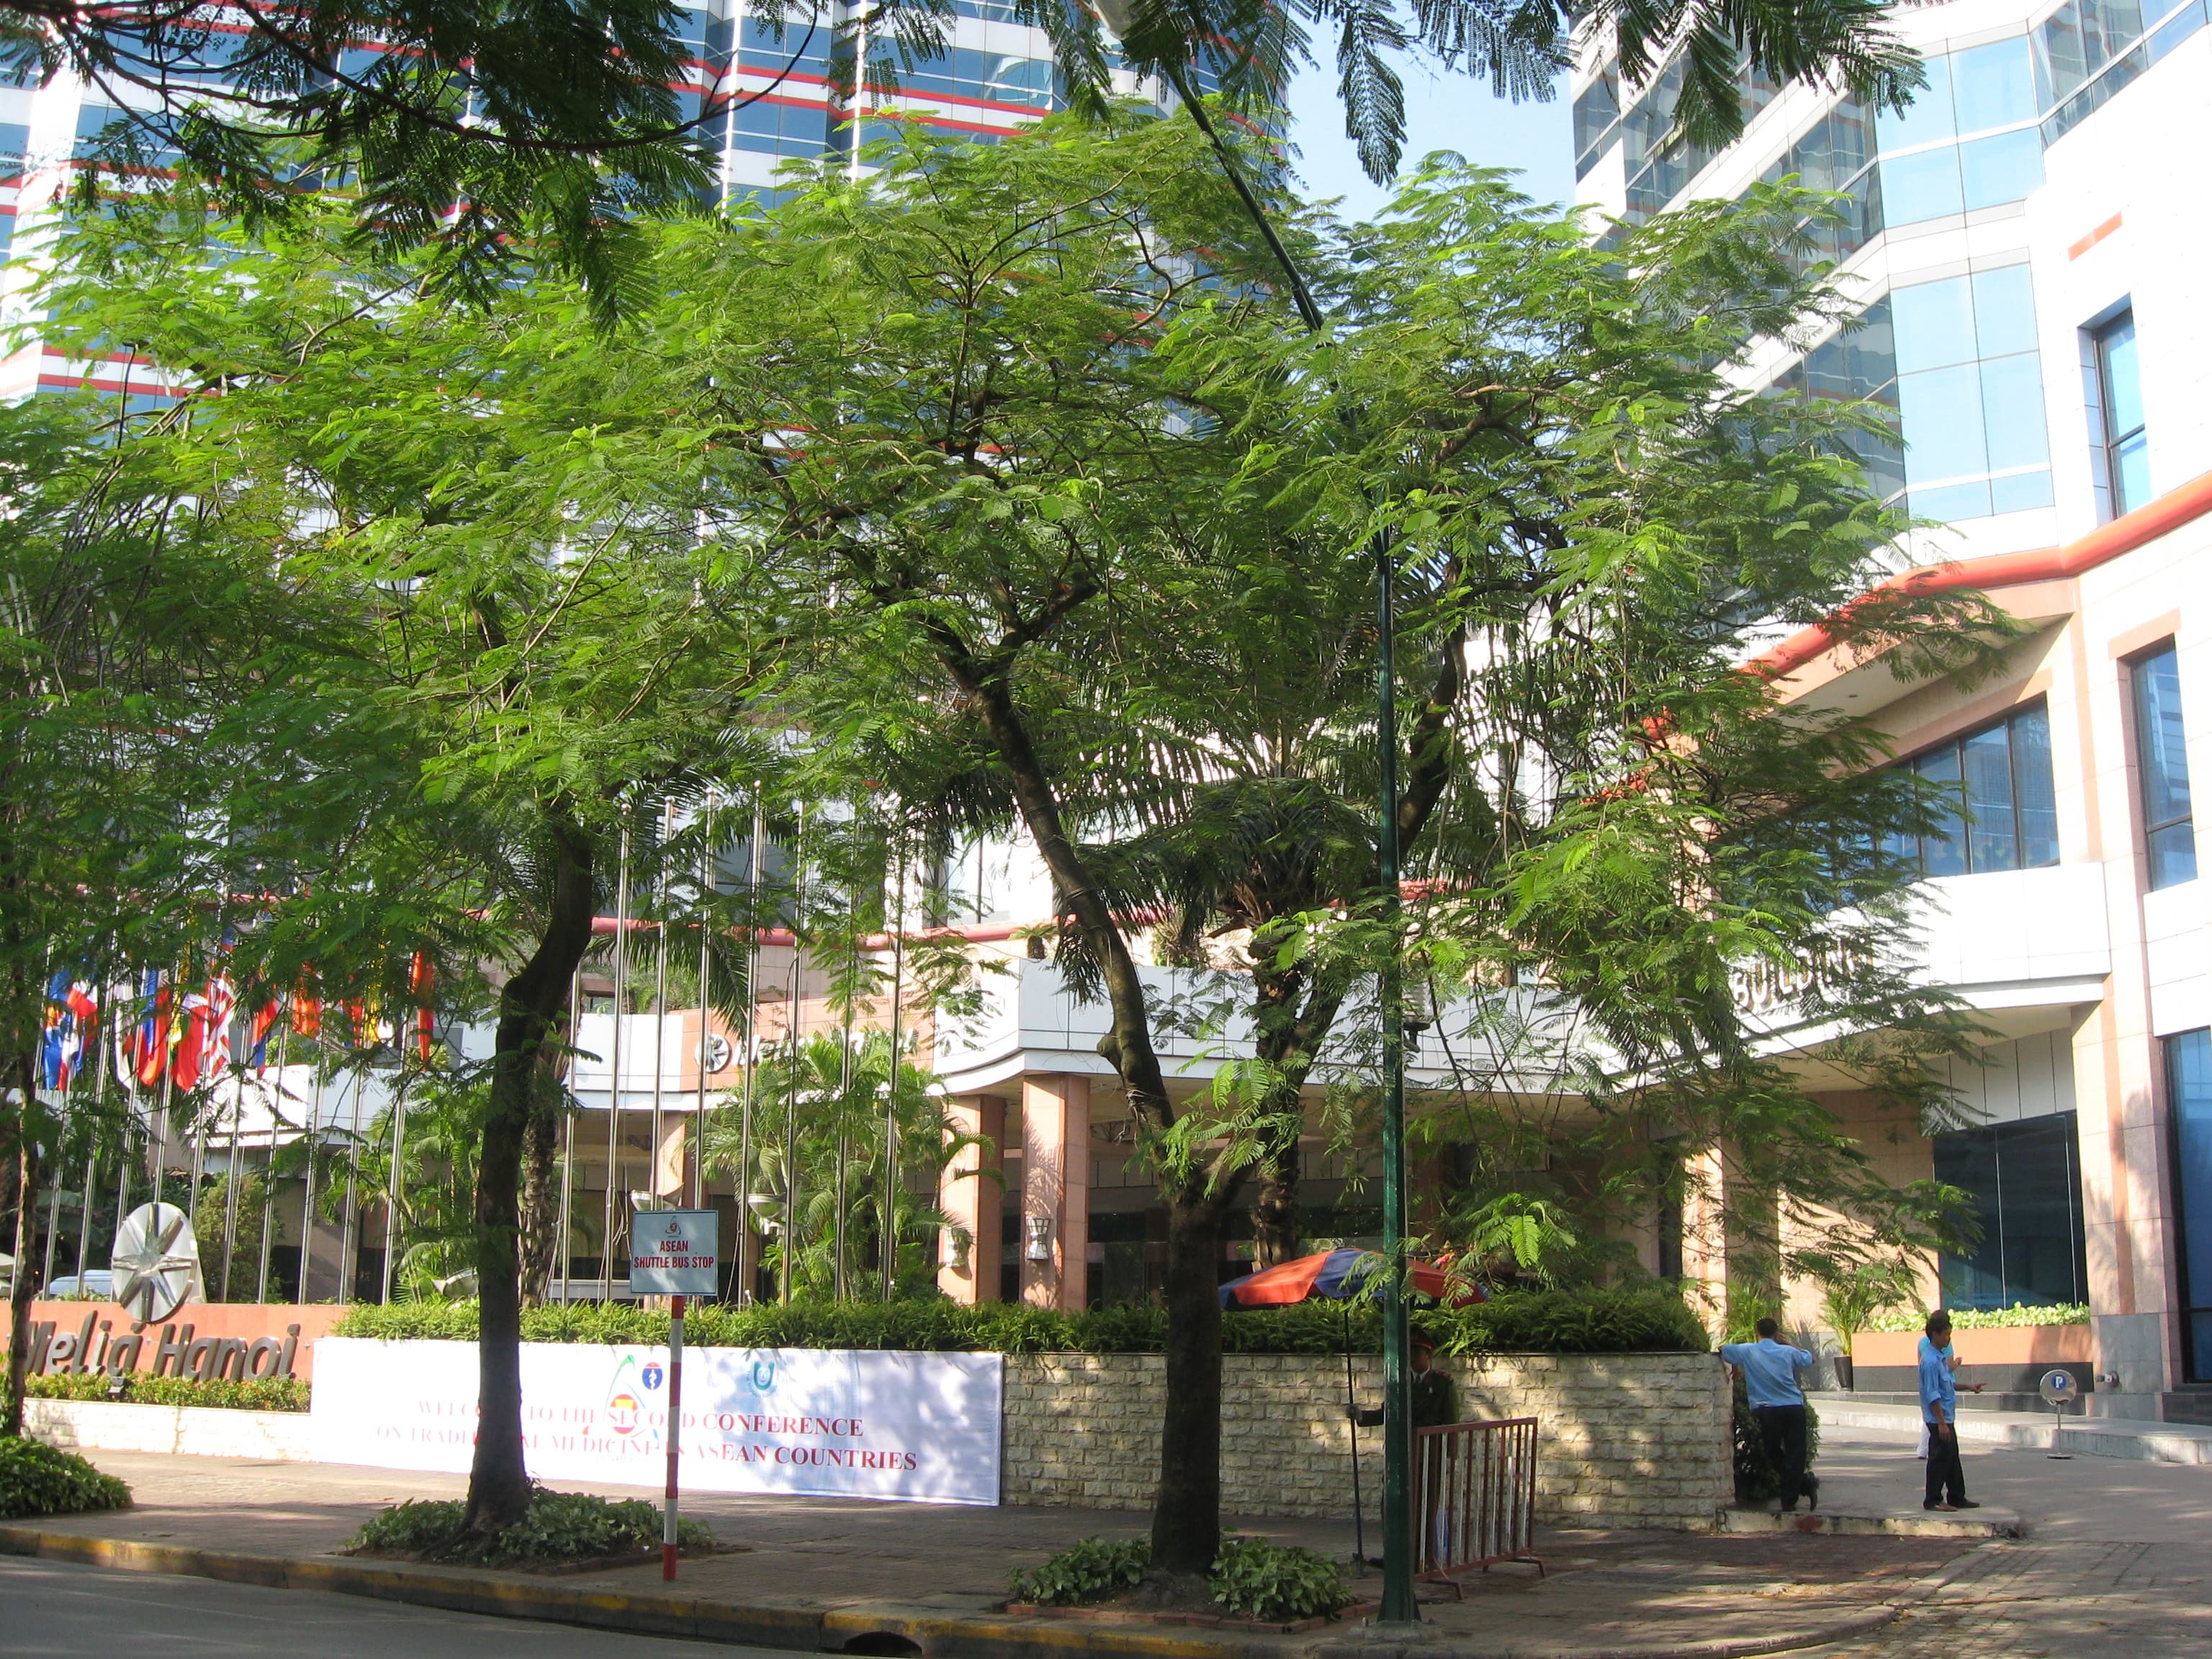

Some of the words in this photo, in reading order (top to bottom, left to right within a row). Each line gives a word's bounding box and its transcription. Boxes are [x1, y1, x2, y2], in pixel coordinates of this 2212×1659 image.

[660, 1241, 688, 1252] ASEAN
[634, 1256, 670, 1268] SHUTTLE
[672, 1256, 690, 1268] BUS
[691, 1256, 714, 1268] STOP
[153, 1323, 302, 1382] Hanoi
[2056, 1375, 2064, 1389] P
[526, 1406, 554, 1422] TO
[561, 1407, 599, 1424] THE
[608, 1409, 696, 1429] SECOD
[703, 1413, 864, 1437] CONFERENCE
[377, 1425, 401, 1439] ON
[552, 1435, 656, 1456] MEDICINE
[693, 1443, 768, 1463] ASEAN
[774, 1446, 917, 1472] COUNTRIES
